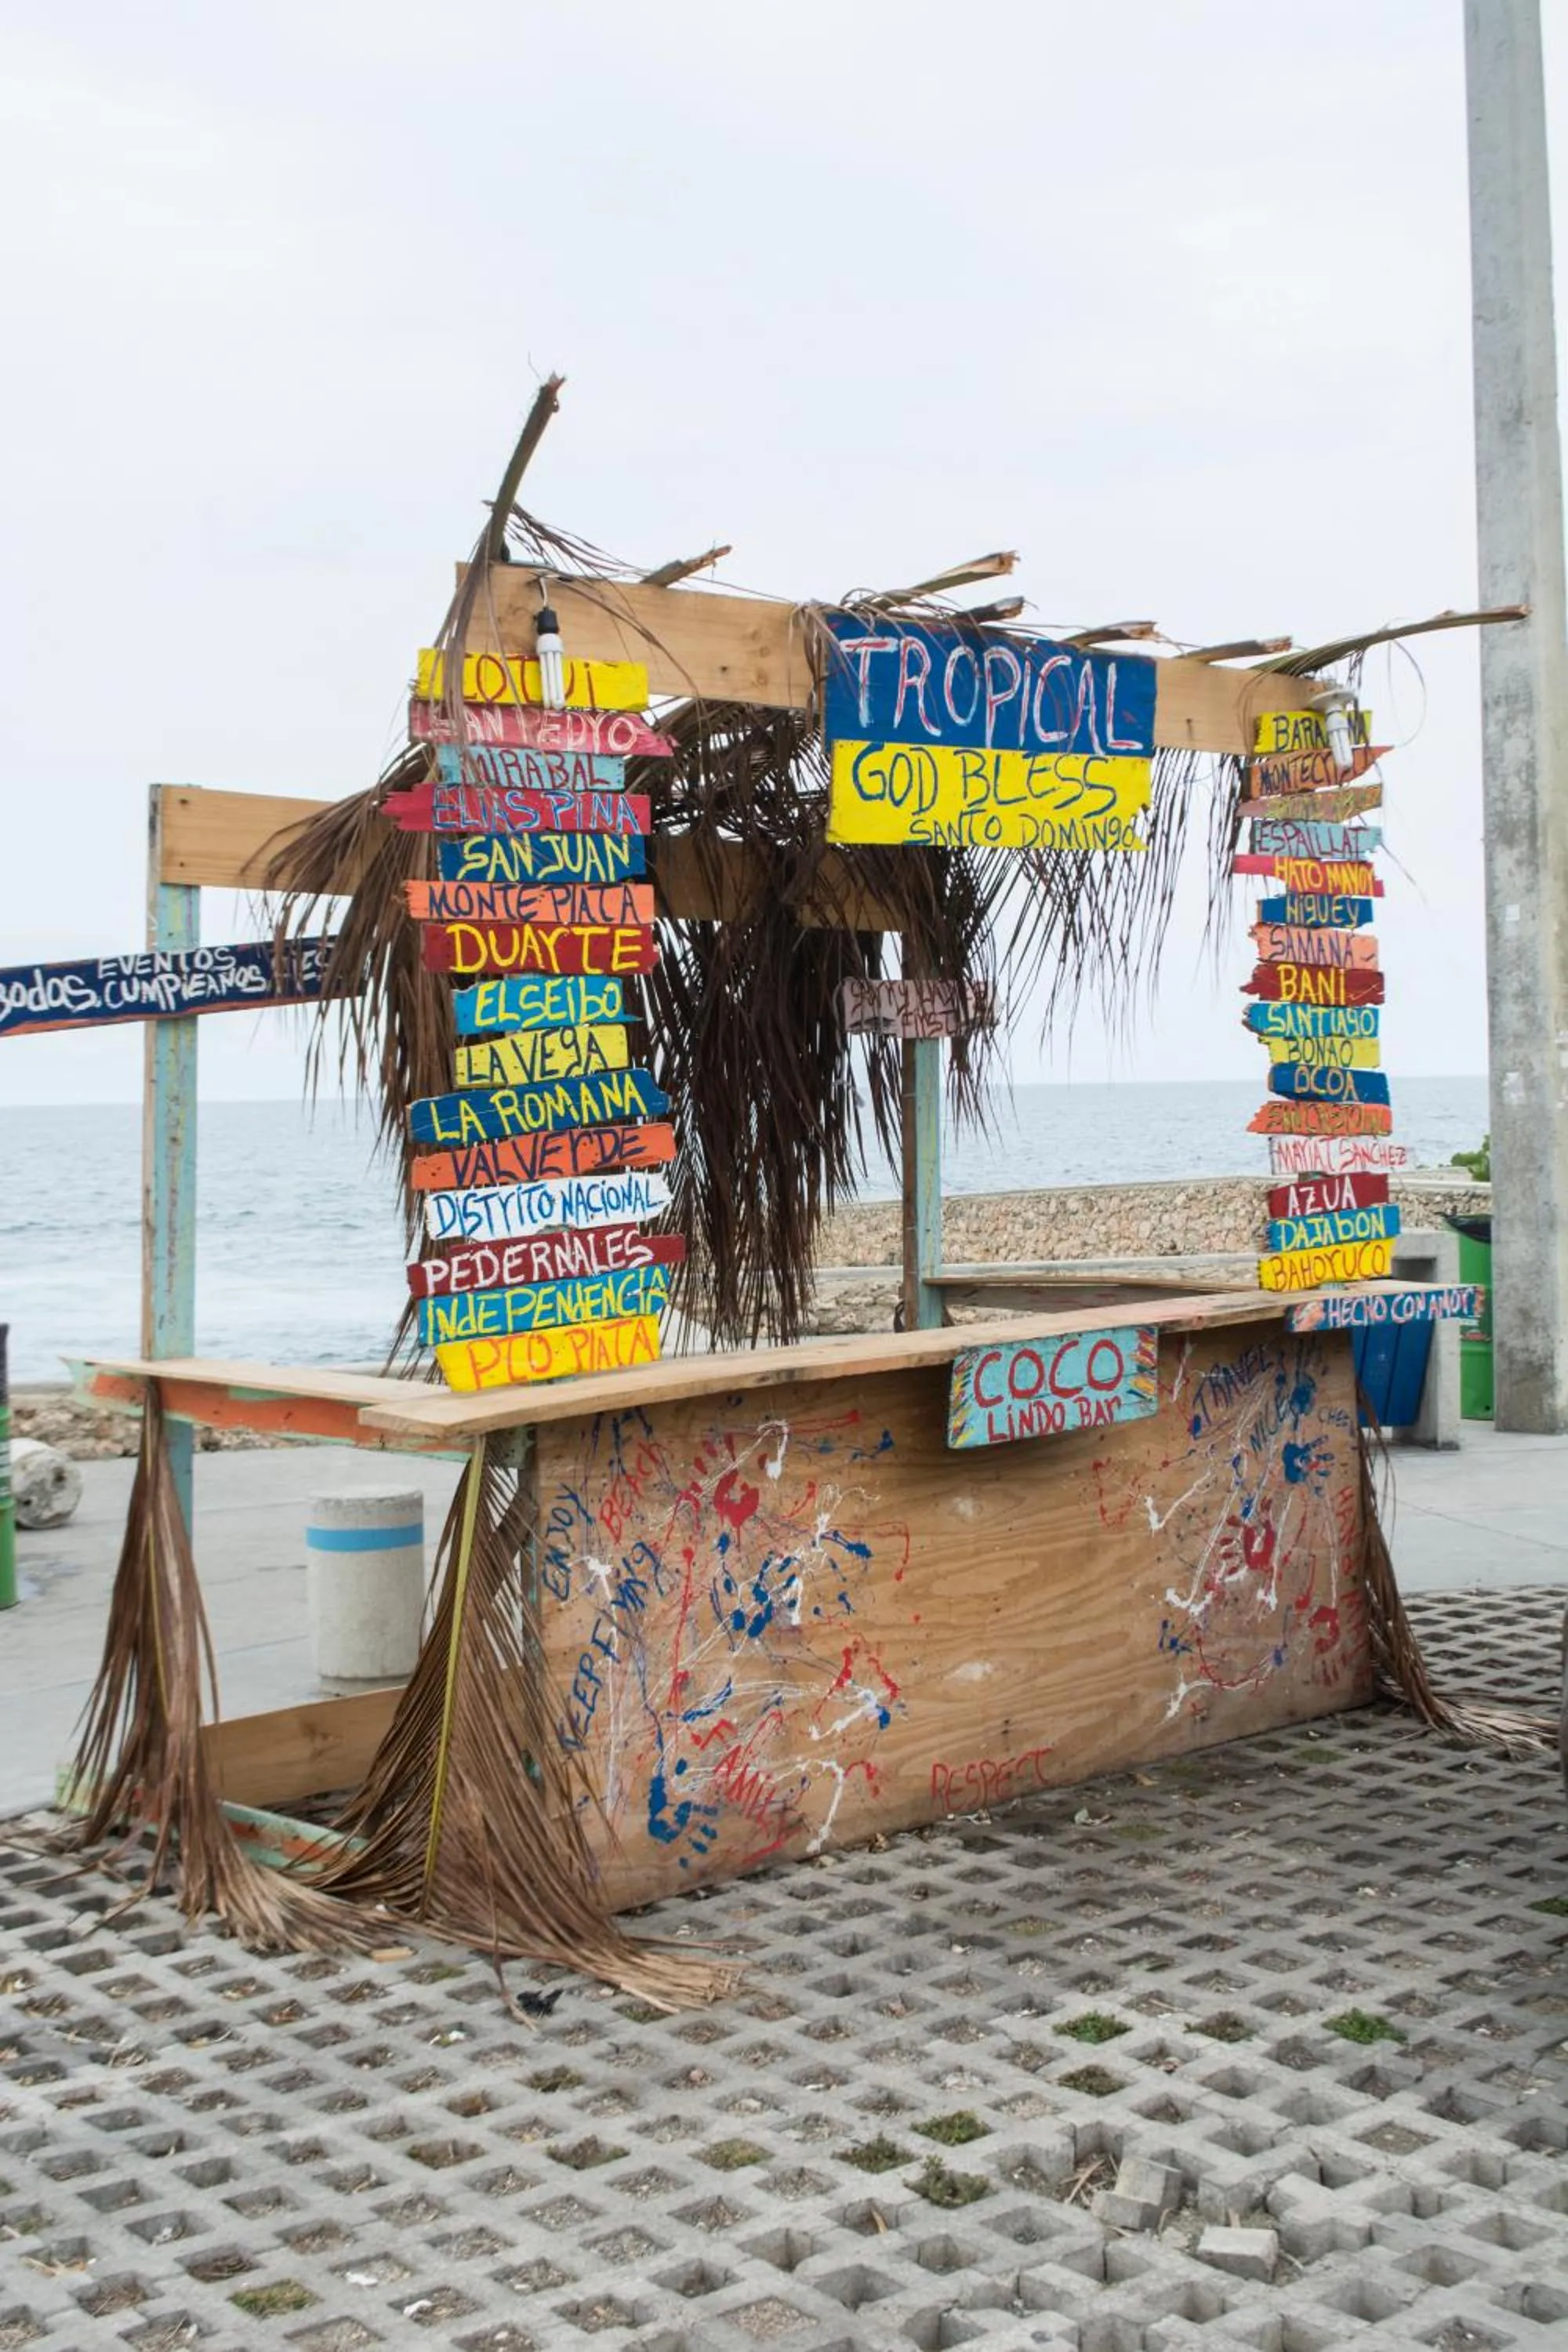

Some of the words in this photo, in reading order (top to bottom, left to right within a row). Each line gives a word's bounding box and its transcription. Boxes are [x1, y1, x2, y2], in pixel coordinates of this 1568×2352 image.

[460, 748, 610, 791] MIRABAL
[852, 742, 938, 815] GOD
[953, 750, 1118, 819] BLESS
[432, 785, 540, 832] ELIAS
[902, 808, 1003, 847] SANTO
[456, 835, 533, 881] SAN
[537, 833, 630, 882] JUAN
[1275, 855, 1324, 892] HATO
[428, 883, 539, 923] MONTE
[98, 946, 237, 979] EVENTOS
[1268, 925, 1355, 968] SAMANA
[474, 982, 521, 1028] EL
[466, 1045, 507, 1083] LA
[1288, 1036, 1354, 1069] BONAO
[1294, 1065, 1359, 1102] OCOA
[430, 1099, 487, 1143] LA
[489, 1072, 648, 1136] ROMANA
[1287, 1174, 1358, 1217] AZUA
[421, 1229, 655, 1296] PEDERNALES
[1327, 1294, 1387, 1328] HECHO
[1391, 1291, 1425, 1323] CON
[468, 1331, 554, 1391] PTO
[974, 1339, 1124, 1409] COCO
[931, 1746, 1054, 1811] RESPECT
